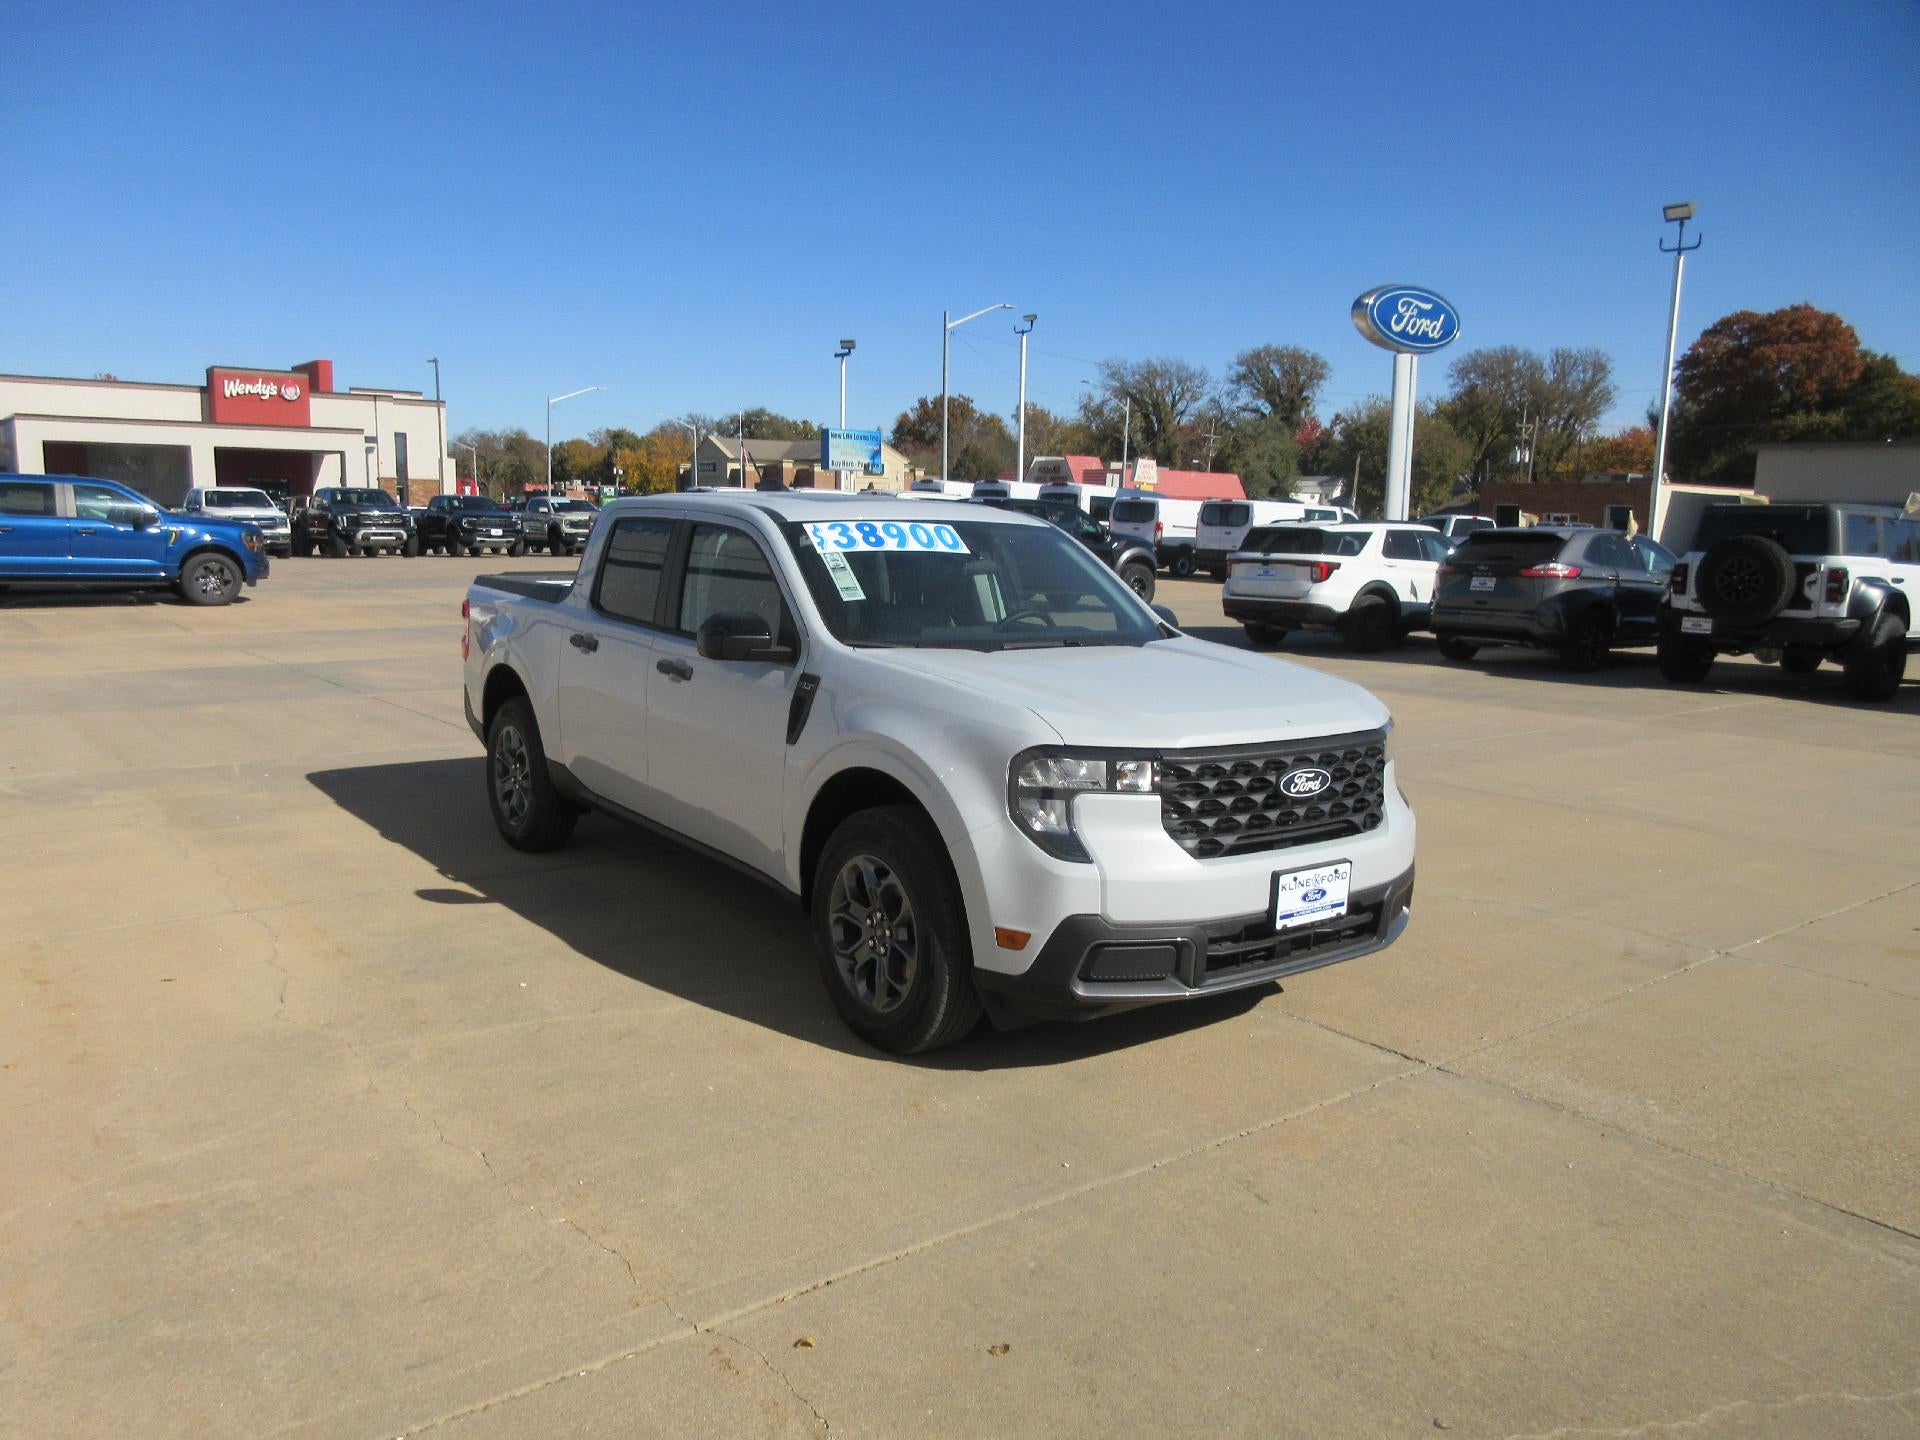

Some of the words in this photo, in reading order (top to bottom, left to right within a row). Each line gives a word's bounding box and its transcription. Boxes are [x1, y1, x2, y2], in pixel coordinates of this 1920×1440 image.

[1391, 297, 1445, 338] Ford
[223, 378, 278, 400] Wendy's
[811, 522, 962, 551] $38900
[1291, 773, 1322, 793] Ford
[1281, 878, 1311, 892] KLINE
[1321, 871, 1348, 885] FORD
